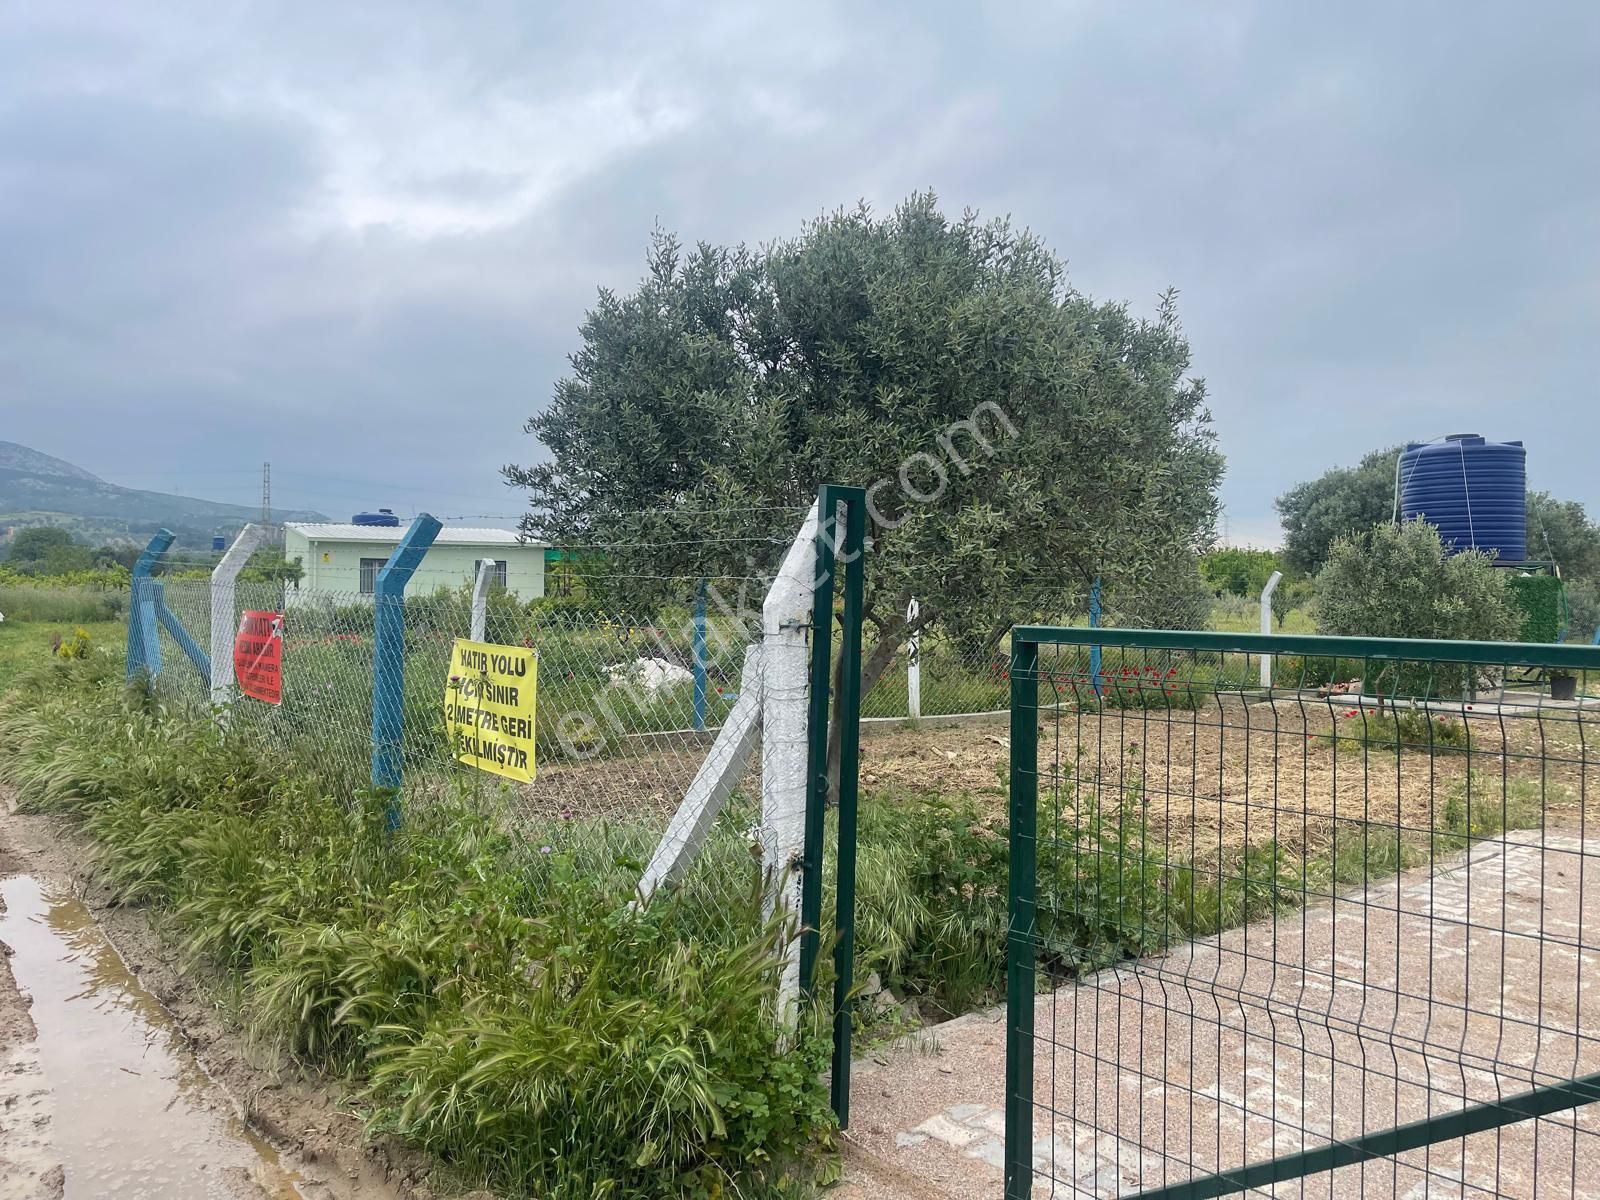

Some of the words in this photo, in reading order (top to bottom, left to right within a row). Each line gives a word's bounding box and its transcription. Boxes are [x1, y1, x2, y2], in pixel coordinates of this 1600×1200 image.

[461, 649, 487, 671] HATIR
[490, 654, 526, 677] YOLU
[485, 682, 519, 707] SINIR
[447, 704, 453, 721] 2
[455, 705, 499, 732] METRE
[500, 714, 532, 740] GERİ
[458, 733, 528, 769] EKİLMİŞTİR
